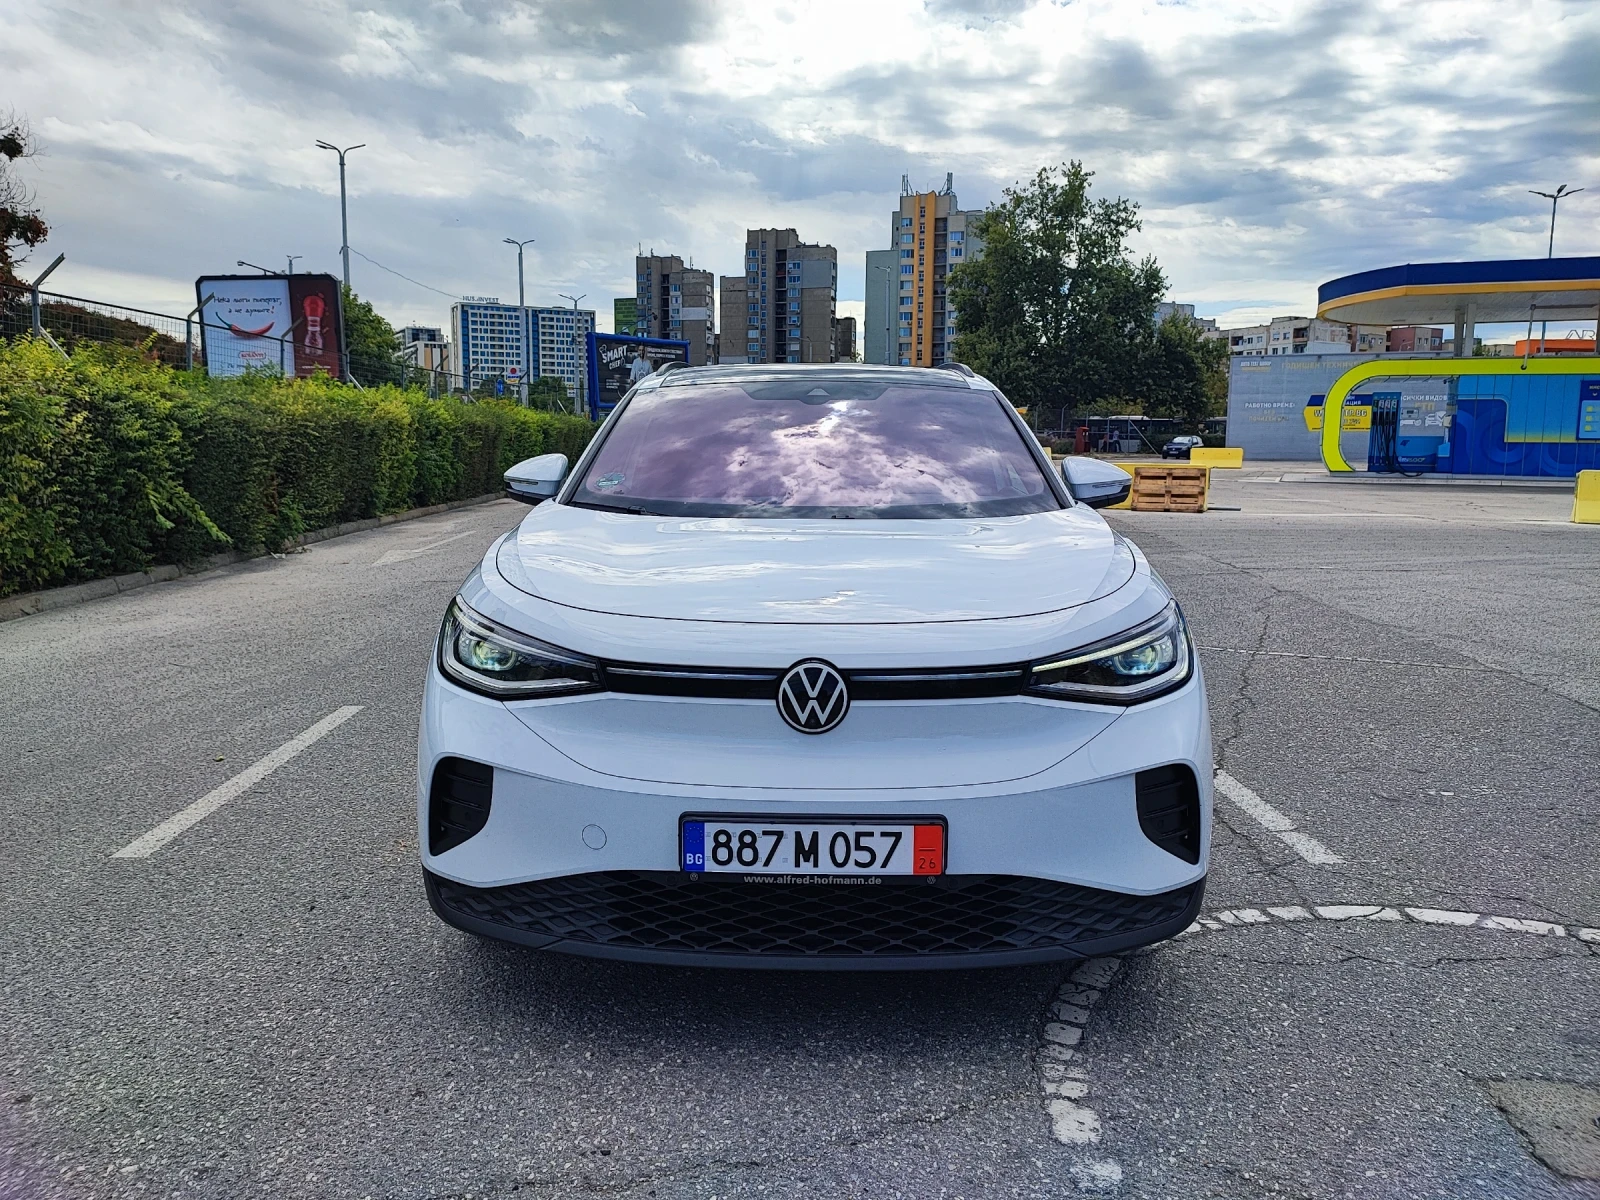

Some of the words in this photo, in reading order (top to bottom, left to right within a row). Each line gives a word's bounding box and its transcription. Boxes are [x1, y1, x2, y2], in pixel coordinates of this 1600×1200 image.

[601, 344, 628, 364] SMART
[608, 360, 622, 370] CHEF
[711, 829, 785, 868] 887
[794, 830, 820, 868] M
[829, 831, 903, 869] 057
[686, 853, 704, 865] BG
[918, 857, 936, 870] 26
[743, 874, 882, 885] www.alfred-hofmann.de
